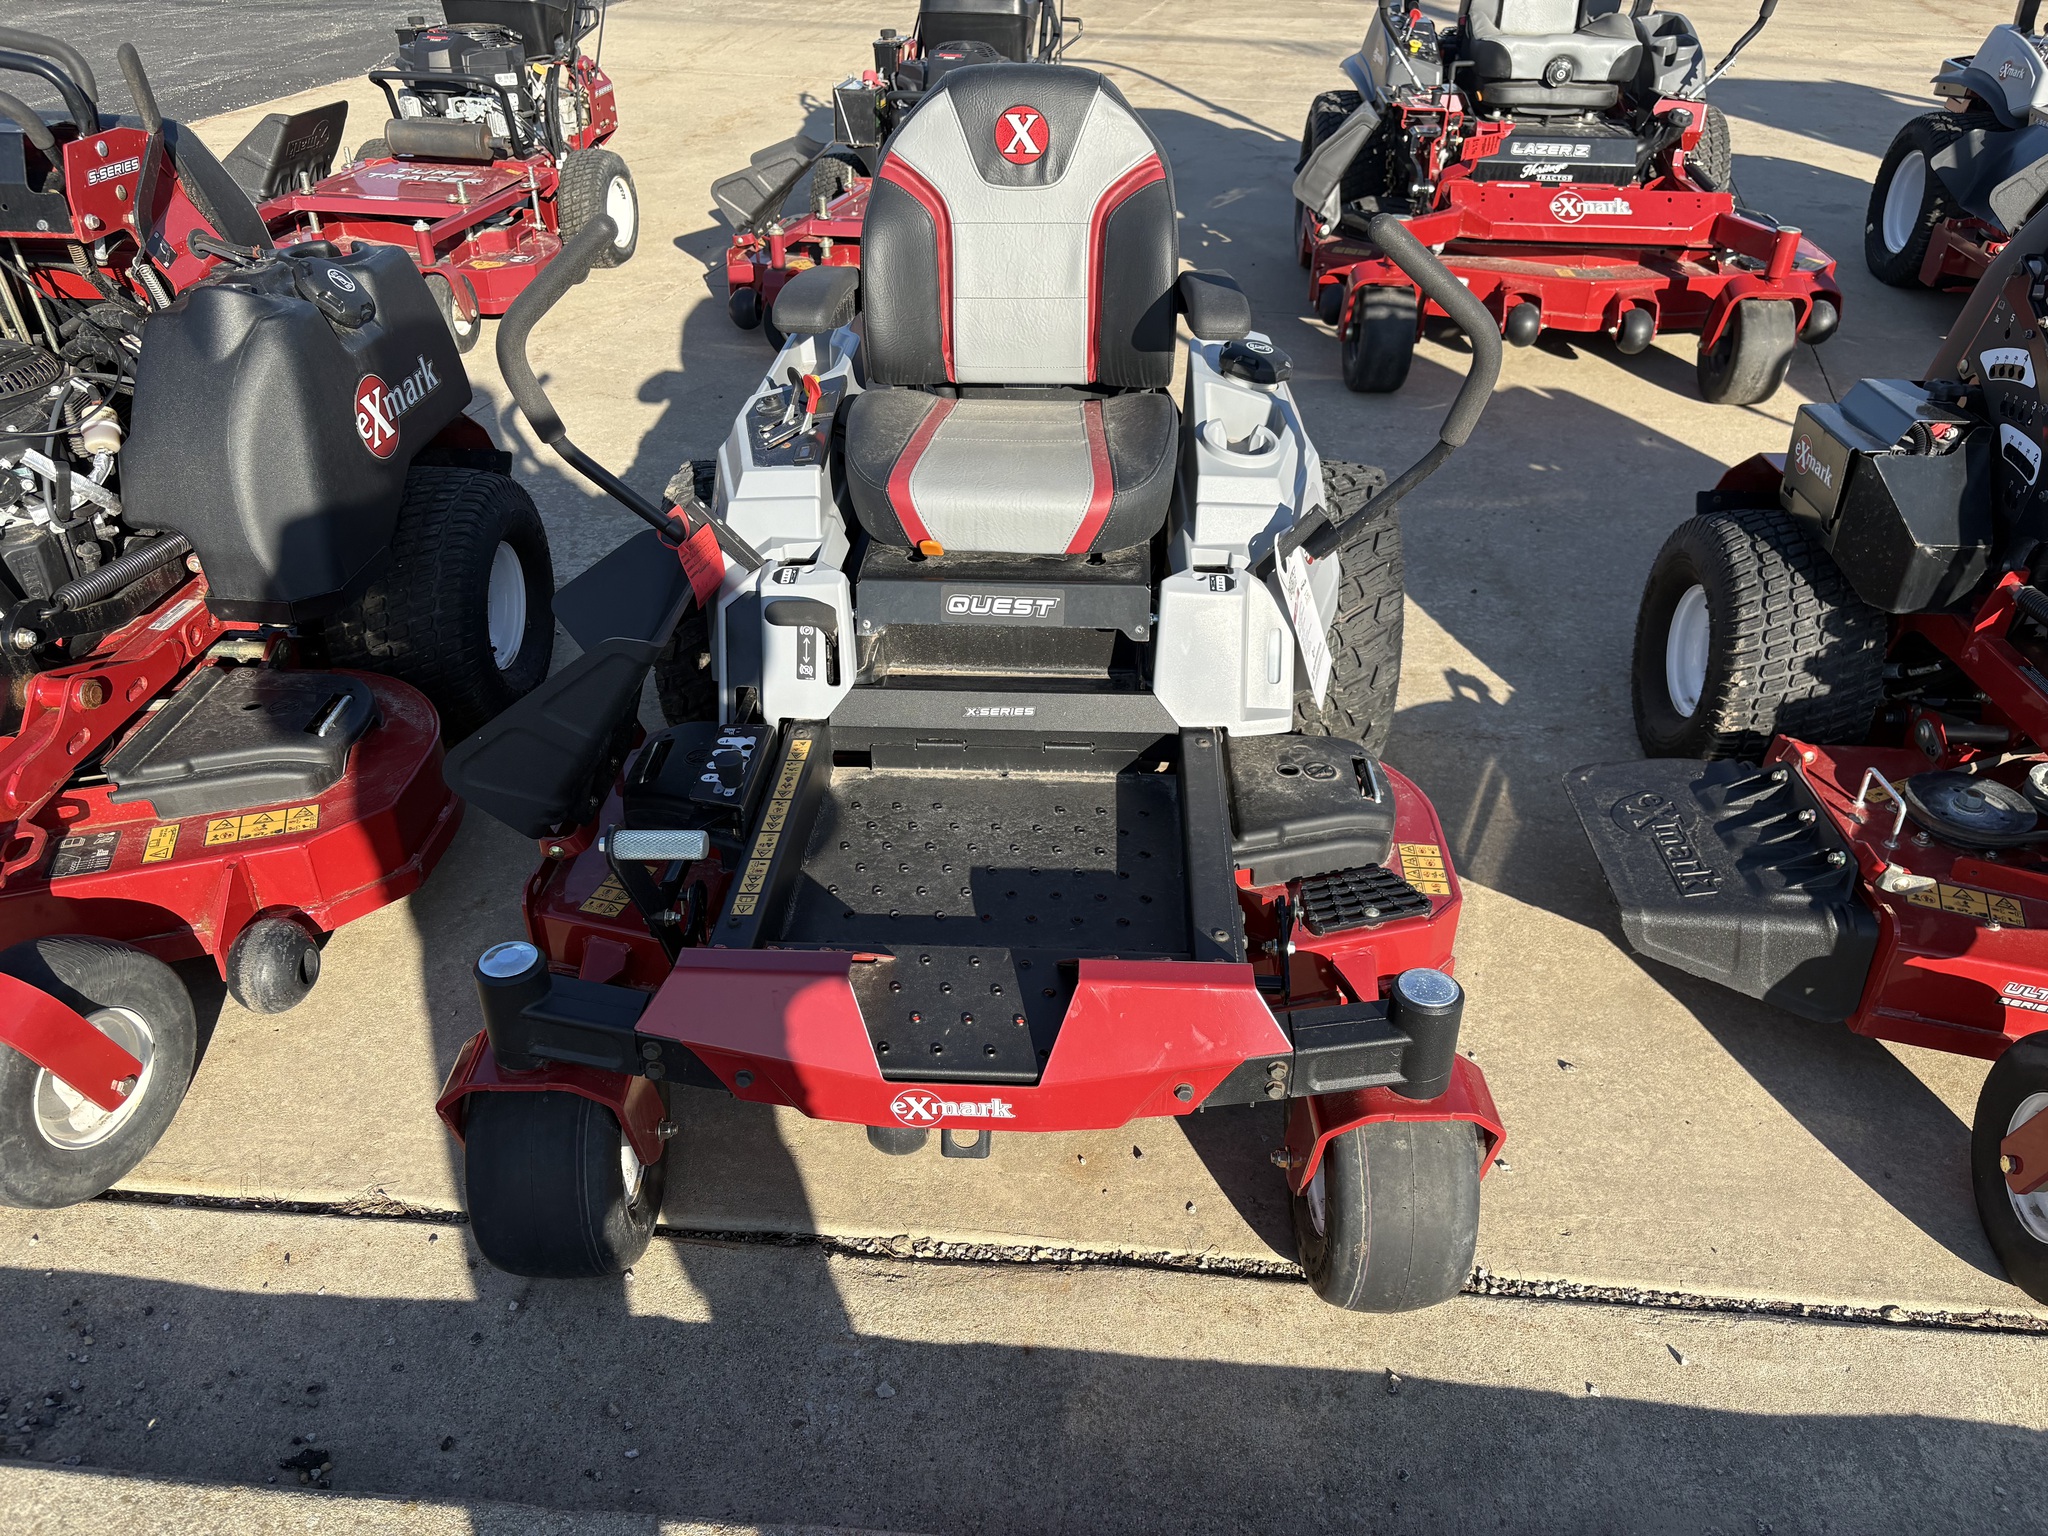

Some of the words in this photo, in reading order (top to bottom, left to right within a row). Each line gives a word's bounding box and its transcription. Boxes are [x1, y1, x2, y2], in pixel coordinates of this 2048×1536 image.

[1003, 113, 1041, 154] X
[1511, 142, 1572, 157] LAZER
[1572, 144, 1591, 158] Z
[1536, 174, 1573, 182] TRACTOR
[1550, 196, 1633, 217] eXmark
[357, 354, 442, 449] eXmark
[1795, 439, 1833, 490] eXmark
[947, 595, 1058, 617] QUEST
[1626, 793, 1713, 890] eXmark
[1998, 997, 2048, 1013] SERIE
[891, 1096, 1016, 1121] eXmark
